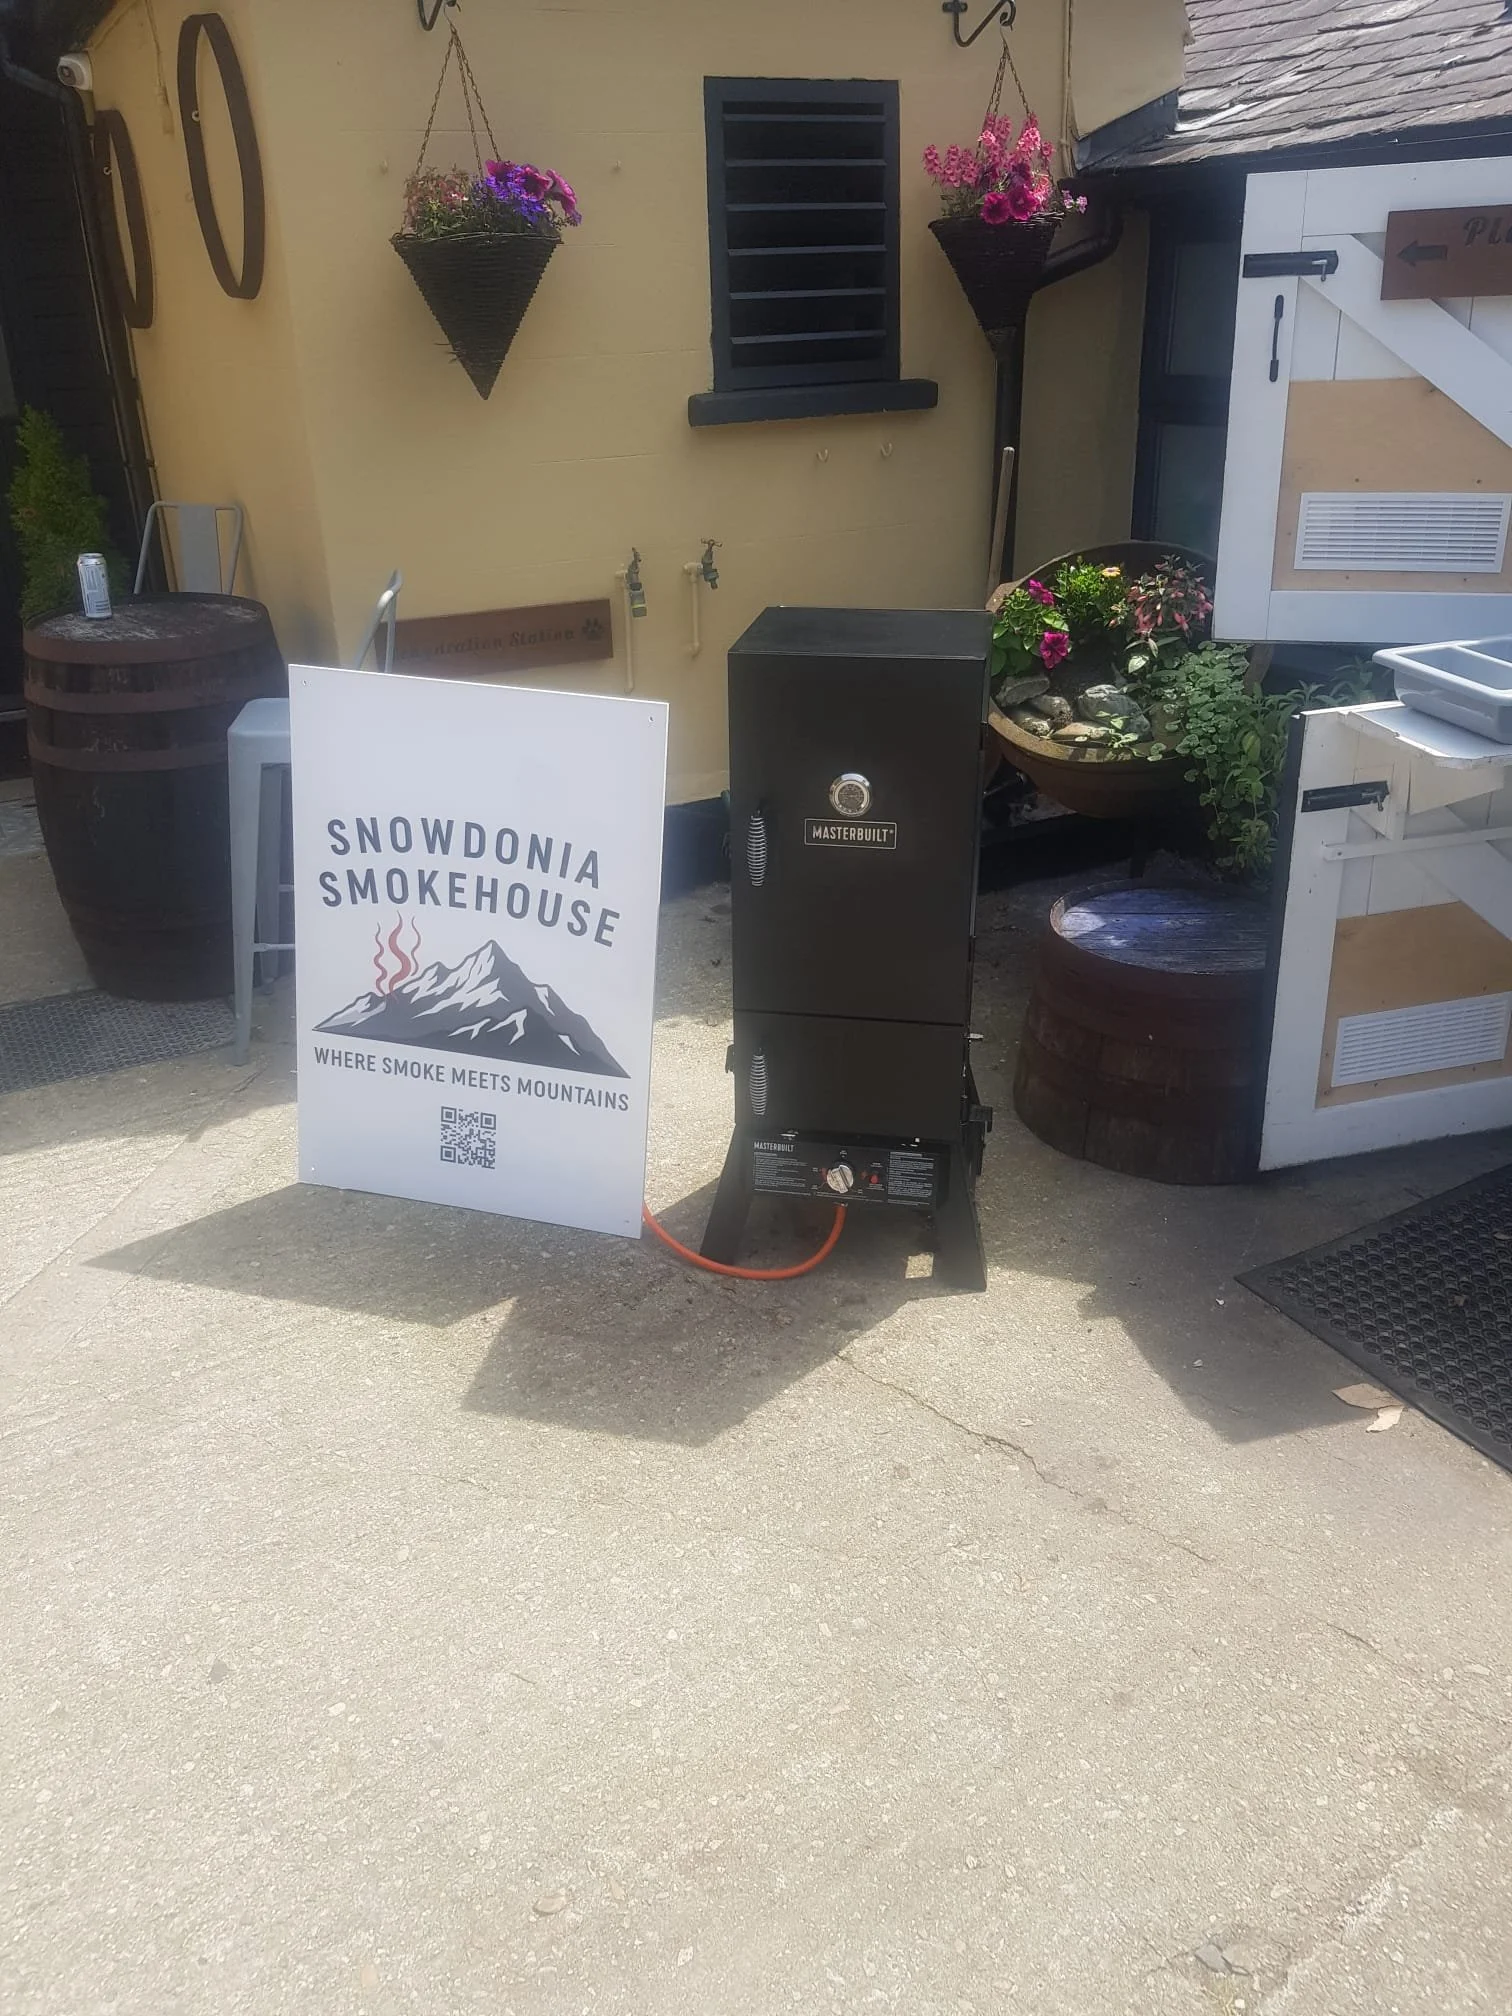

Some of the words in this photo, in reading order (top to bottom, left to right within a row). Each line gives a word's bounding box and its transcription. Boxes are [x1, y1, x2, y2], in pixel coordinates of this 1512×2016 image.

[327, 816, 599, 889] SNOWDONIA
[319, 867, 620, 948] SMOKEHOUSE
[314, 1046, 377, 1073] WHERE
[382, 1056, 446, 1083] SMOKE
[451, 1067, 512, 1093] MEETS
[517, 1077, 630, 1112] MOUNTAINS
[753, 1141, 795, 1153] MASTERBUILT
